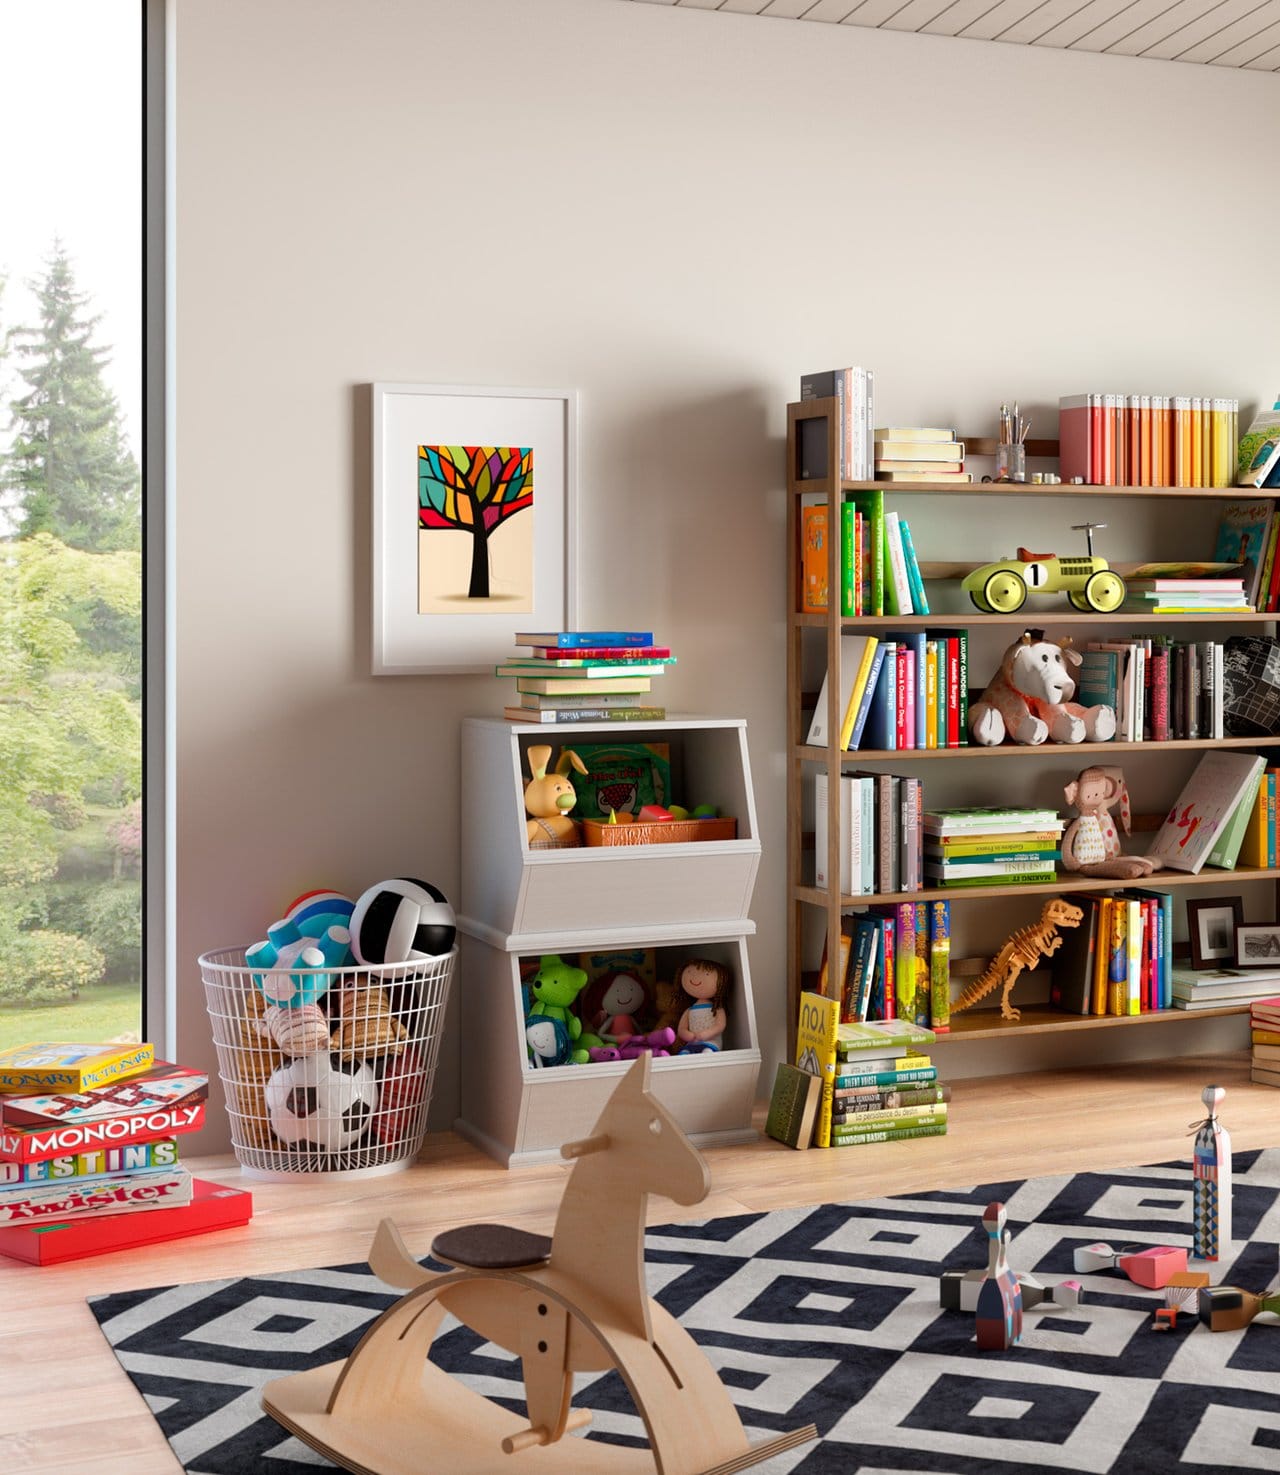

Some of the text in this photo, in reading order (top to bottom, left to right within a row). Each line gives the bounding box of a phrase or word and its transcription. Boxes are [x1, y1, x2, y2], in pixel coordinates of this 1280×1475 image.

[1030, 564, 1040, 586] 1
[866, 658, 881, 695] ANTARCTIC
[801, 1003, 826, 1036] YOU
[0, 1072, 78, 1086] IONARY
[81, 1050, 152, 1088] PICTIONARY
[824, 1082, 832, 1102] YOU
[29, 1106, 201, 1155] MONOPOLY
[838, 1134, 866, 1145] HANDGUN
[866, 1132, 887, 1142] BASICS
[0, 1143, 175, 1185] DESTINS
[0, 1182, 181, 1220] Twister
